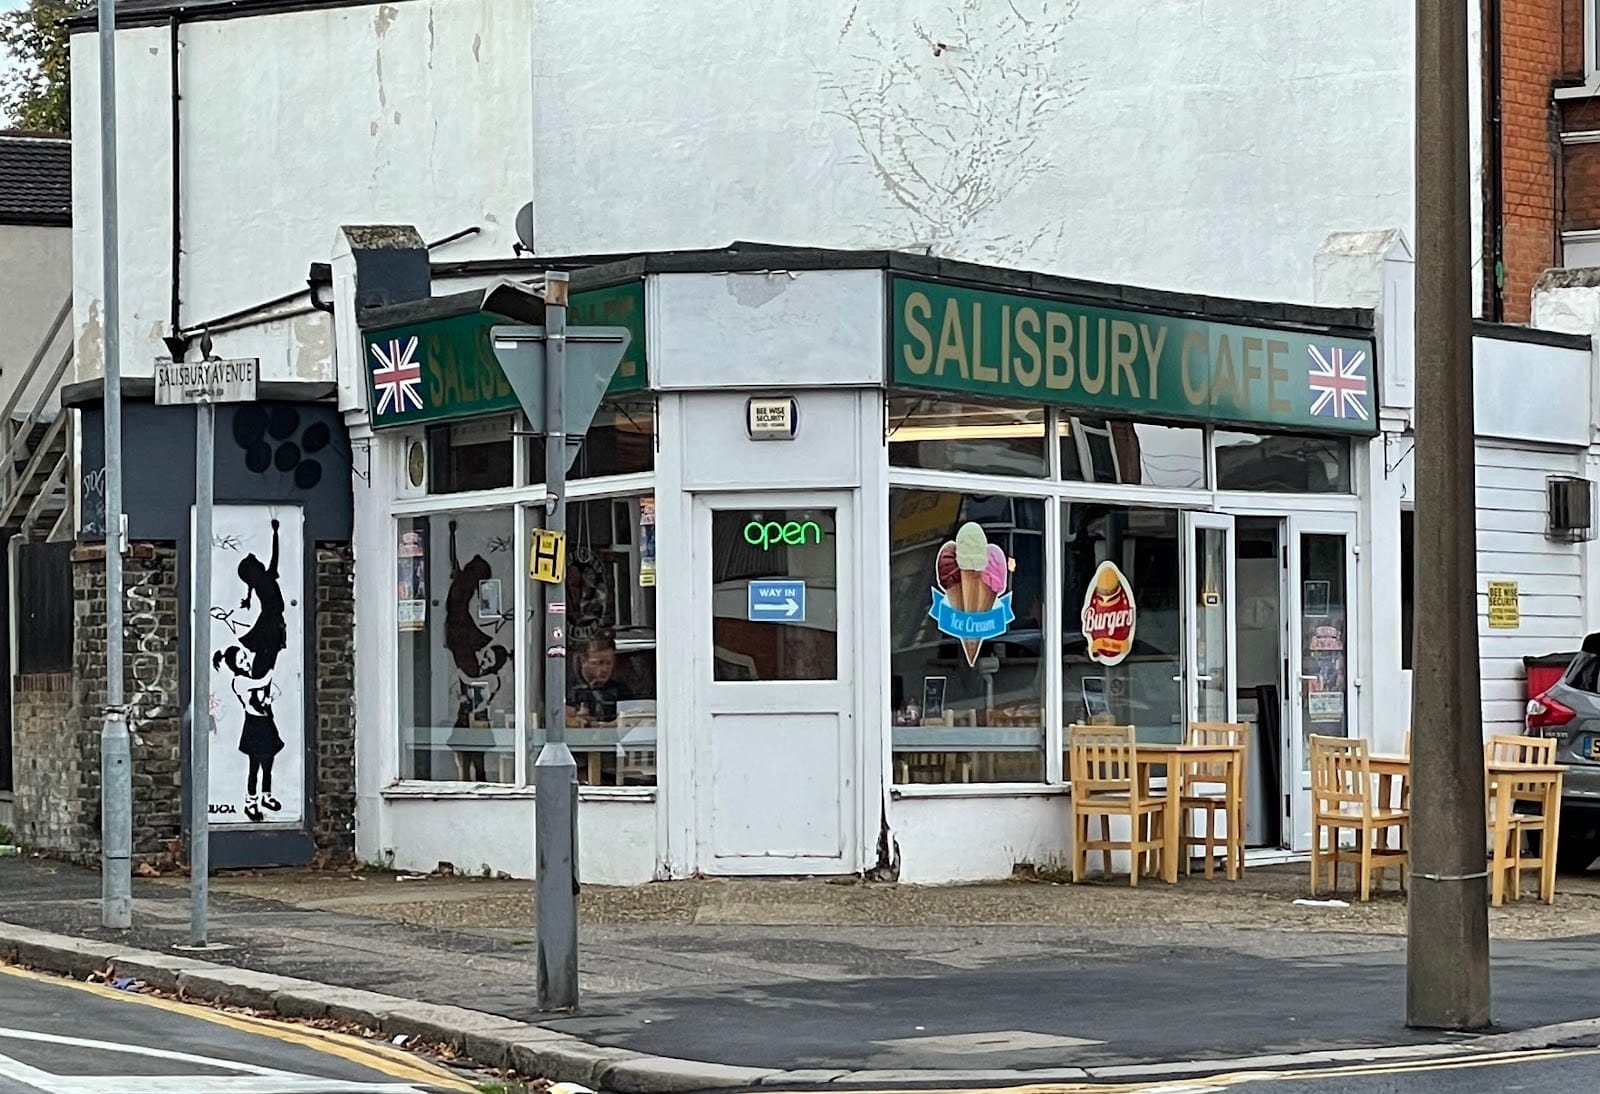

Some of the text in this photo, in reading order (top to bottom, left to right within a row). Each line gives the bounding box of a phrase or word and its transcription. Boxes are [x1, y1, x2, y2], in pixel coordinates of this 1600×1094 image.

[903, 292, 1292, 414] SALISBURY CAFE
[159, 363, 252, 387] SALISBURY AVENUE
[756, 407, 785, 415] BEE WISE
[744, 521, 821, 551] open
[534, 534, 559, 578] H
[759, 588, 796, 598] WAY IN
[1489, 597, 1518, 607] SECURITY
[1490, 587, 1518, 598] BEE WISE
[950, 613, 996, 633] Ice Cream
[1085, 607, 1133, 636] Burgers
